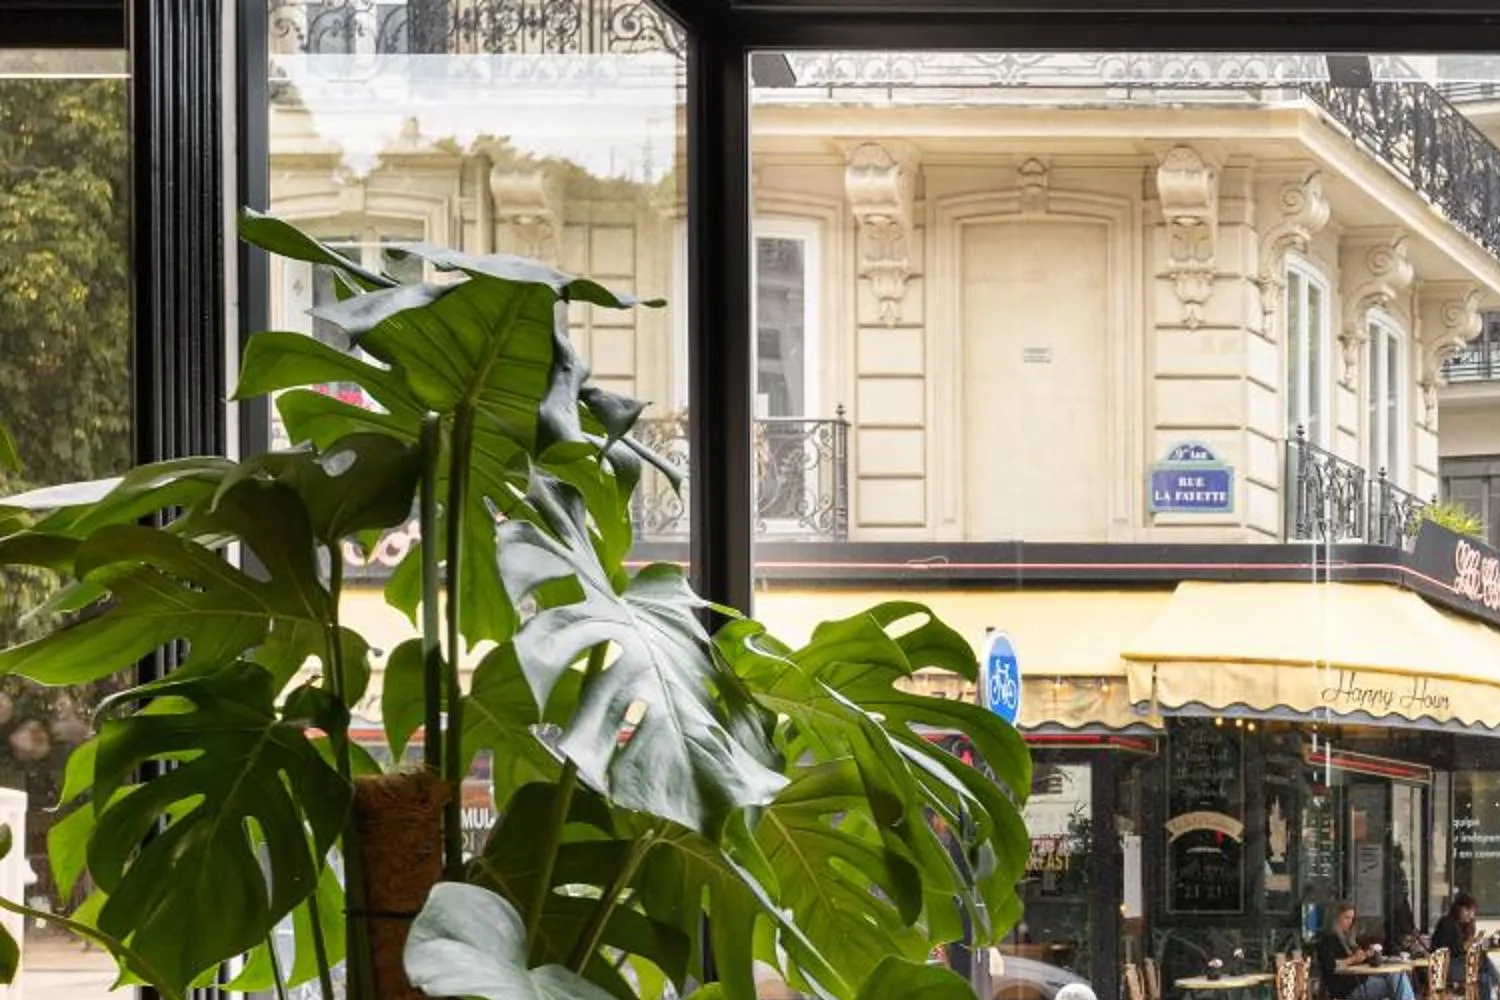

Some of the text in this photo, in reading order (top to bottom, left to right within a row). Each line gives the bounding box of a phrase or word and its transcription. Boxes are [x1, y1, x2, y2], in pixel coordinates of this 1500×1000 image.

[1178, 476, 1204, 487] RUE
[1154, 491, 1226, 502] LA FAYETTE
[1321, 668, 1393, 710] Happy
